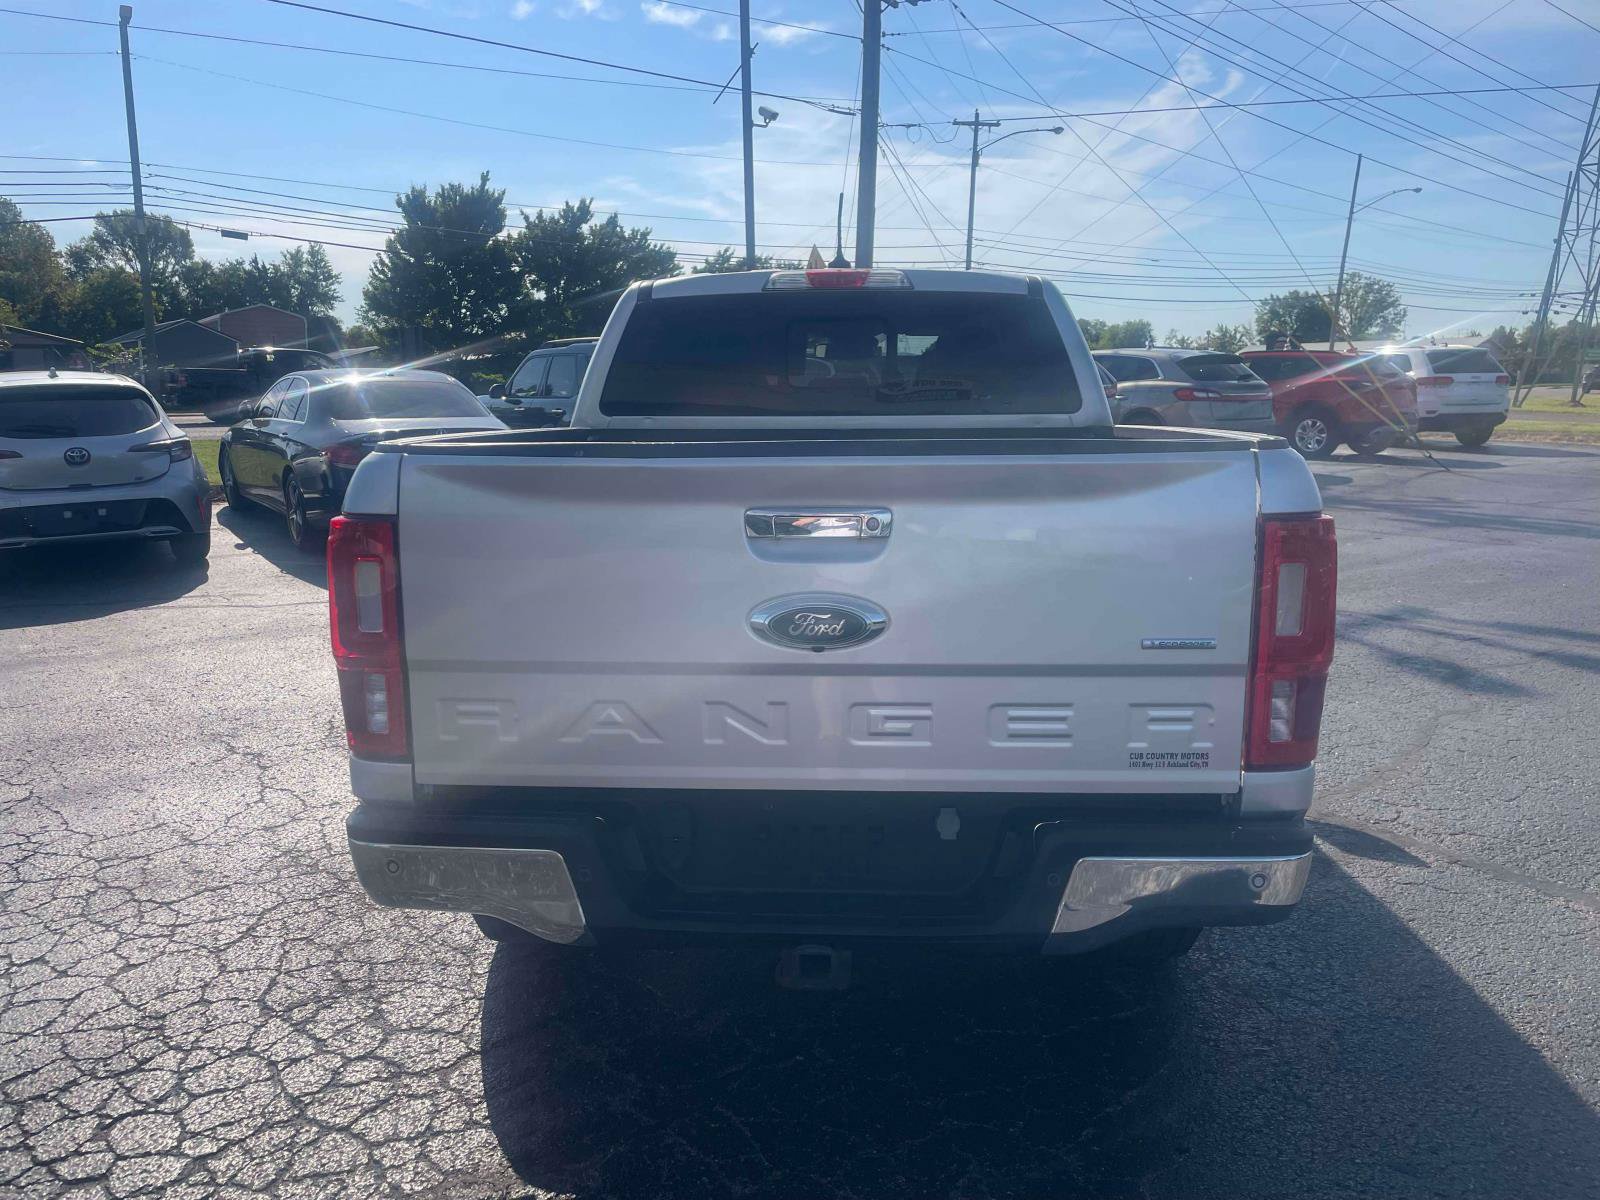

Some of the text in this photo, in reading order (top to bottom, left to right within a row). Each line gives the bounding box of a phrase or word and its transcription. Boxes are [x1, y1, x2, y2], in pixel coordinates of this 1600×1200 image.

[788, 612, 846, 636] Ford
[435, 698, 1216, 748] RANGER
[1129, 752, 1210, 760] CUB COUNTRY MOTORS
